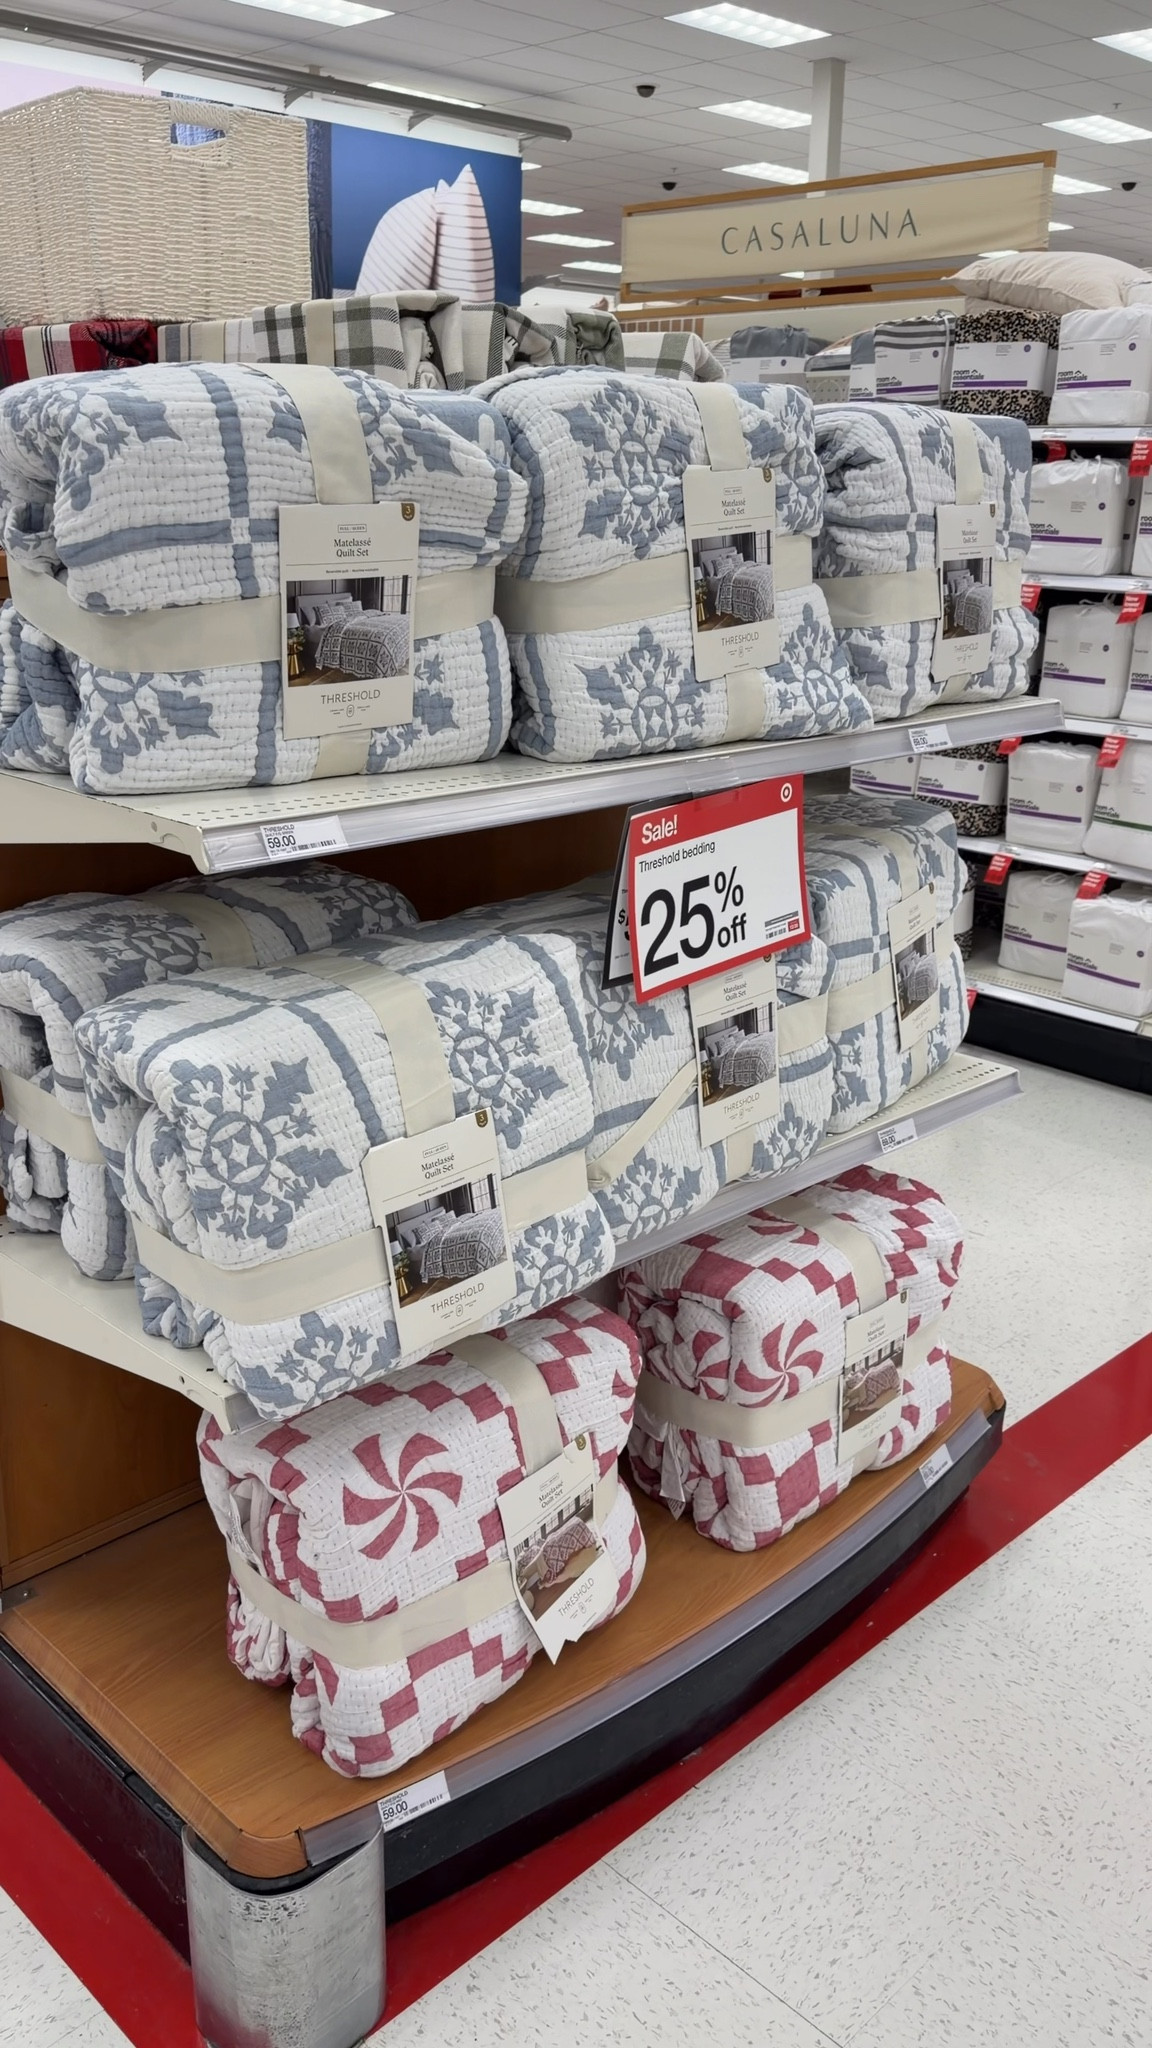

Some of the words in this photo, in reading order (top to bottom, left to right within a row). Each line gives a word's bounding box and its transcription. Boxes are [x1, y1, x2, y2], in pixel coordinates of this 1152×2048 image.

[721, 208, 918, 255] CASALUNA
[1057, 374, 1088, 382] essentials
[405, 505, 411, 514] 3
[736, 507, 745, 515] Set
[333, 537, 372, 548] Matelassé
[336, 549, 355, 558] Quilt
[356, 548, 369, 557] Set
[721, 631, 760, 646] THRESHOLD
[320, 689, 381, 704] THRESHOLD
[263, 824, 294, 833] THRESHOLD
[641, 814, 678, 845] Sale!
[267, 835, 296, 849] 59.00
[638, 850, 680, 873] Threshold
[682, 842, 716, 859] bedding
[717, 912, 747, 948] off
[724, 1092, 760, 1114] THRESHOLD
[421, 1153, 455, 1172] Matelassé
[424, 1167, 441, 1179] Quilt
[442, 1163, 454, 1173] Set
[431, 1282, 485, 1313] THRESHOLD
[541, 1496, 555, 1508] Quilt
[554, 1489, 563, 1499] Set
[558, 1577, 595, 1617] THRESHOLD
[382, 1801, 408, 1820] 59.00
